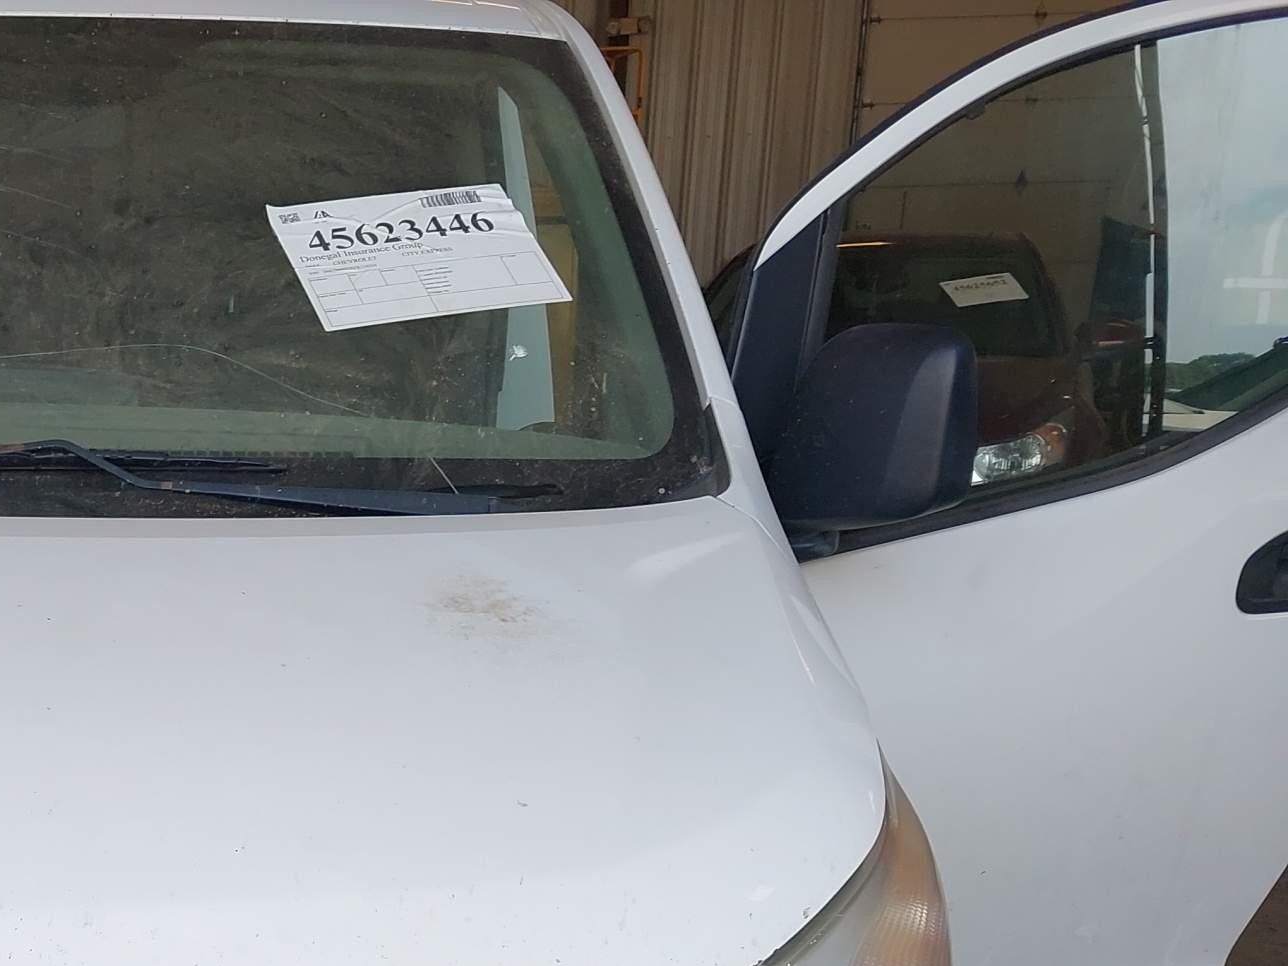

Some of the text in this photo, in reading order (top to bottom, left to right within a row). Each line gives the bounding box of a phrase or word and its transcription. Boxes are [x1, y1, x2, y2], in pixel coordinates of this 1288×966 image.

[309, 211, 494, 251] 45623446
[299, 242, 424, 263] Donegal Insurance Group
